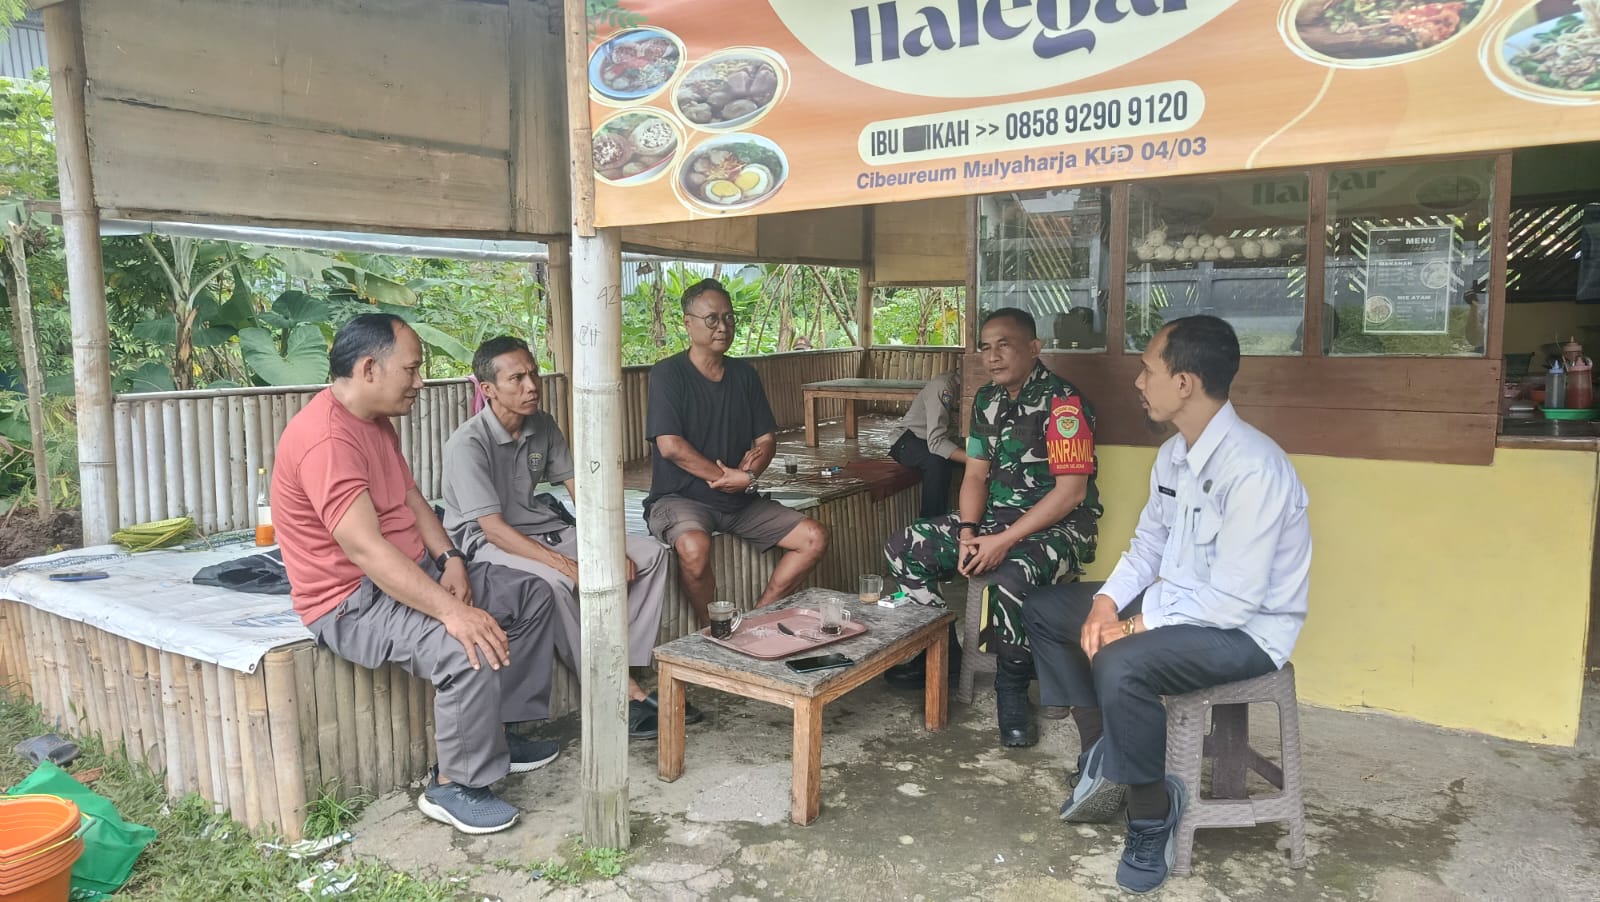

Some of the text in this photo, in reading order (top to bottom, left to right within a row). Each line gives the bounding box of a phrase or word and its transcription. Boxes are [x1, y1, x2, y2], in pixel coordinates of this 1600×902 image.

[850, 0, 1188, 66] Haleg
[871, 128, 899, 157] IBU
[902, 119, 969, 153] IKAH
[1005, 107, 1059, 141] 0858
[1065, 99, 1121, 134] 9290
[1128, 90, 1188, 127] 9120
[856, 166, 957, 190] Cibeureum
[963, 151, 1077, 180] Mulyaharja
[1141, 136, 1207, 162] 04/03
[1405, 236, 1436, 245] MENU
